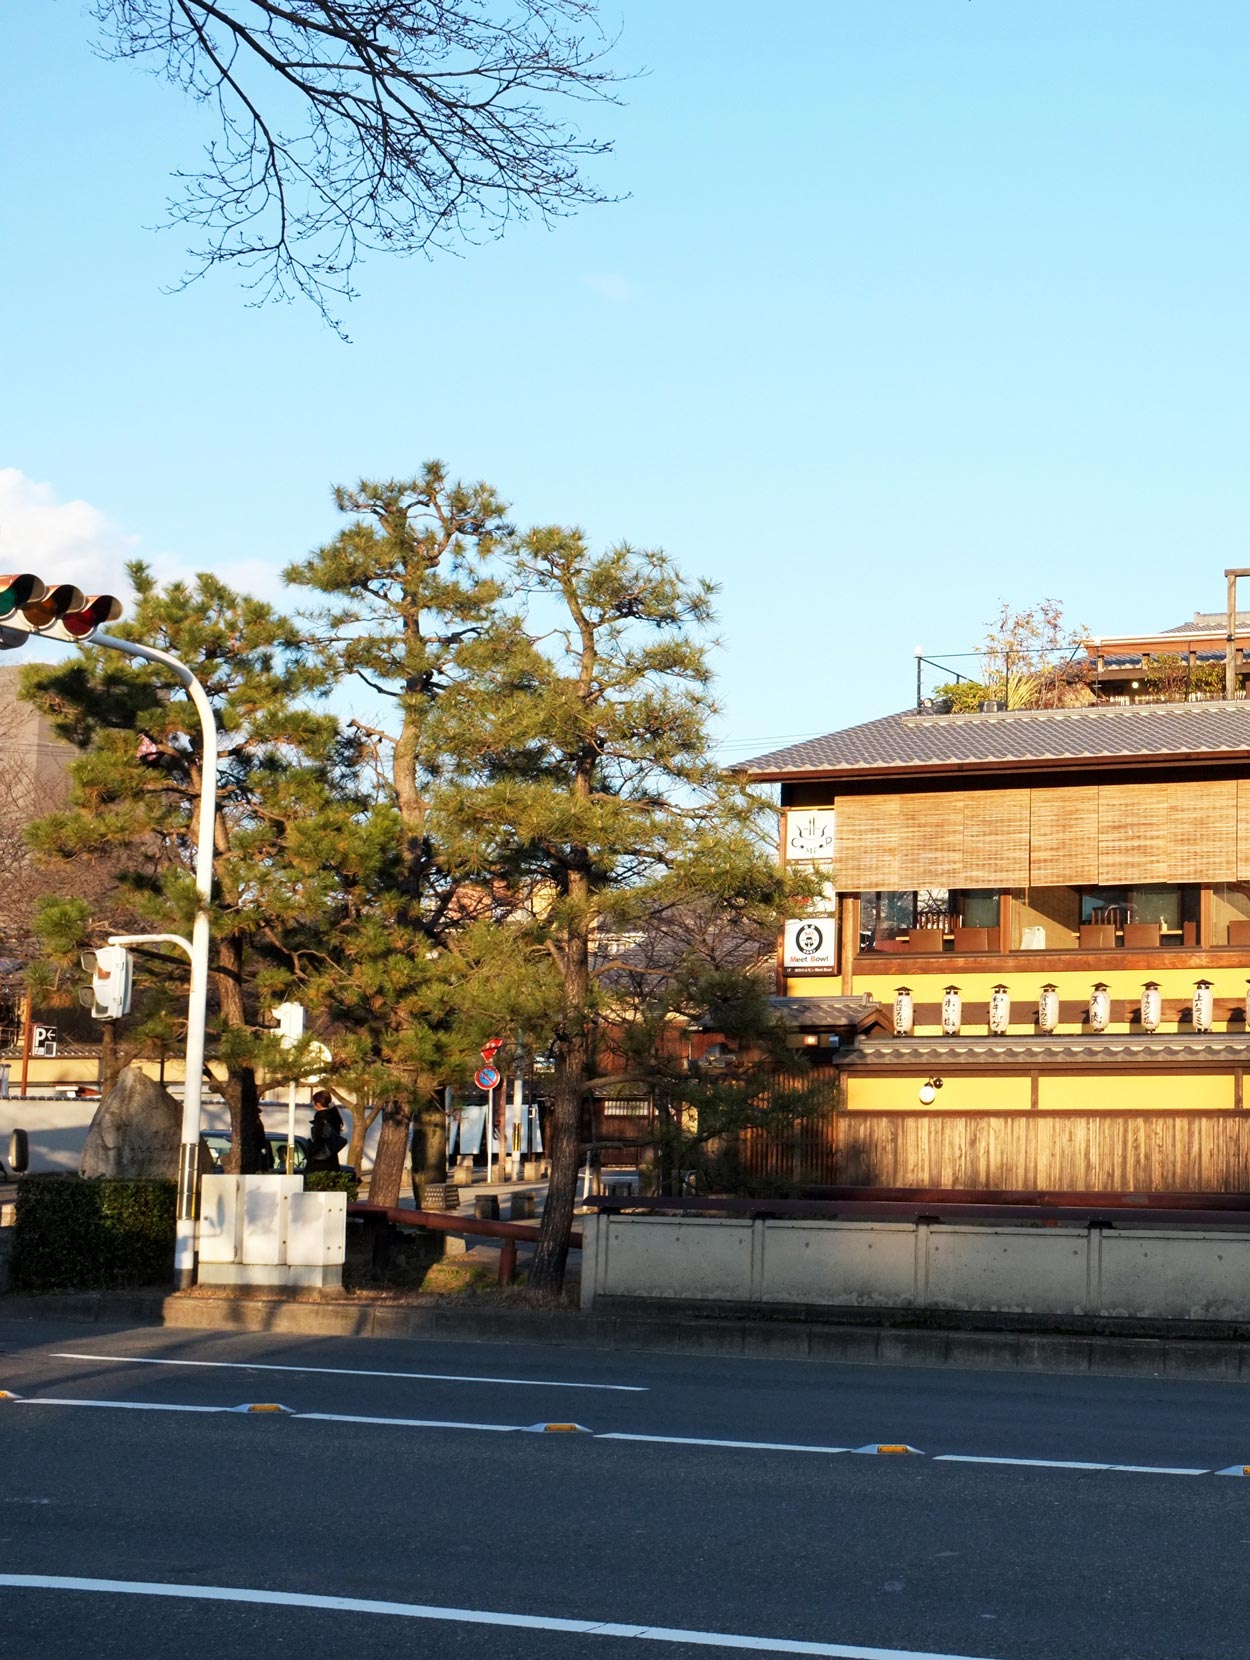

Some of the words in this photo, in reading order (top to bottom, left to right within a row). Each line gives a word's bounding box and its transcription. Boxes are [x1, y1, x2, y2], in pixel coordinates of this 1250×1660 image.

[1194, 992, 1203, 1026] 上ハラミ
[35, 1027, 47, 1047] P
